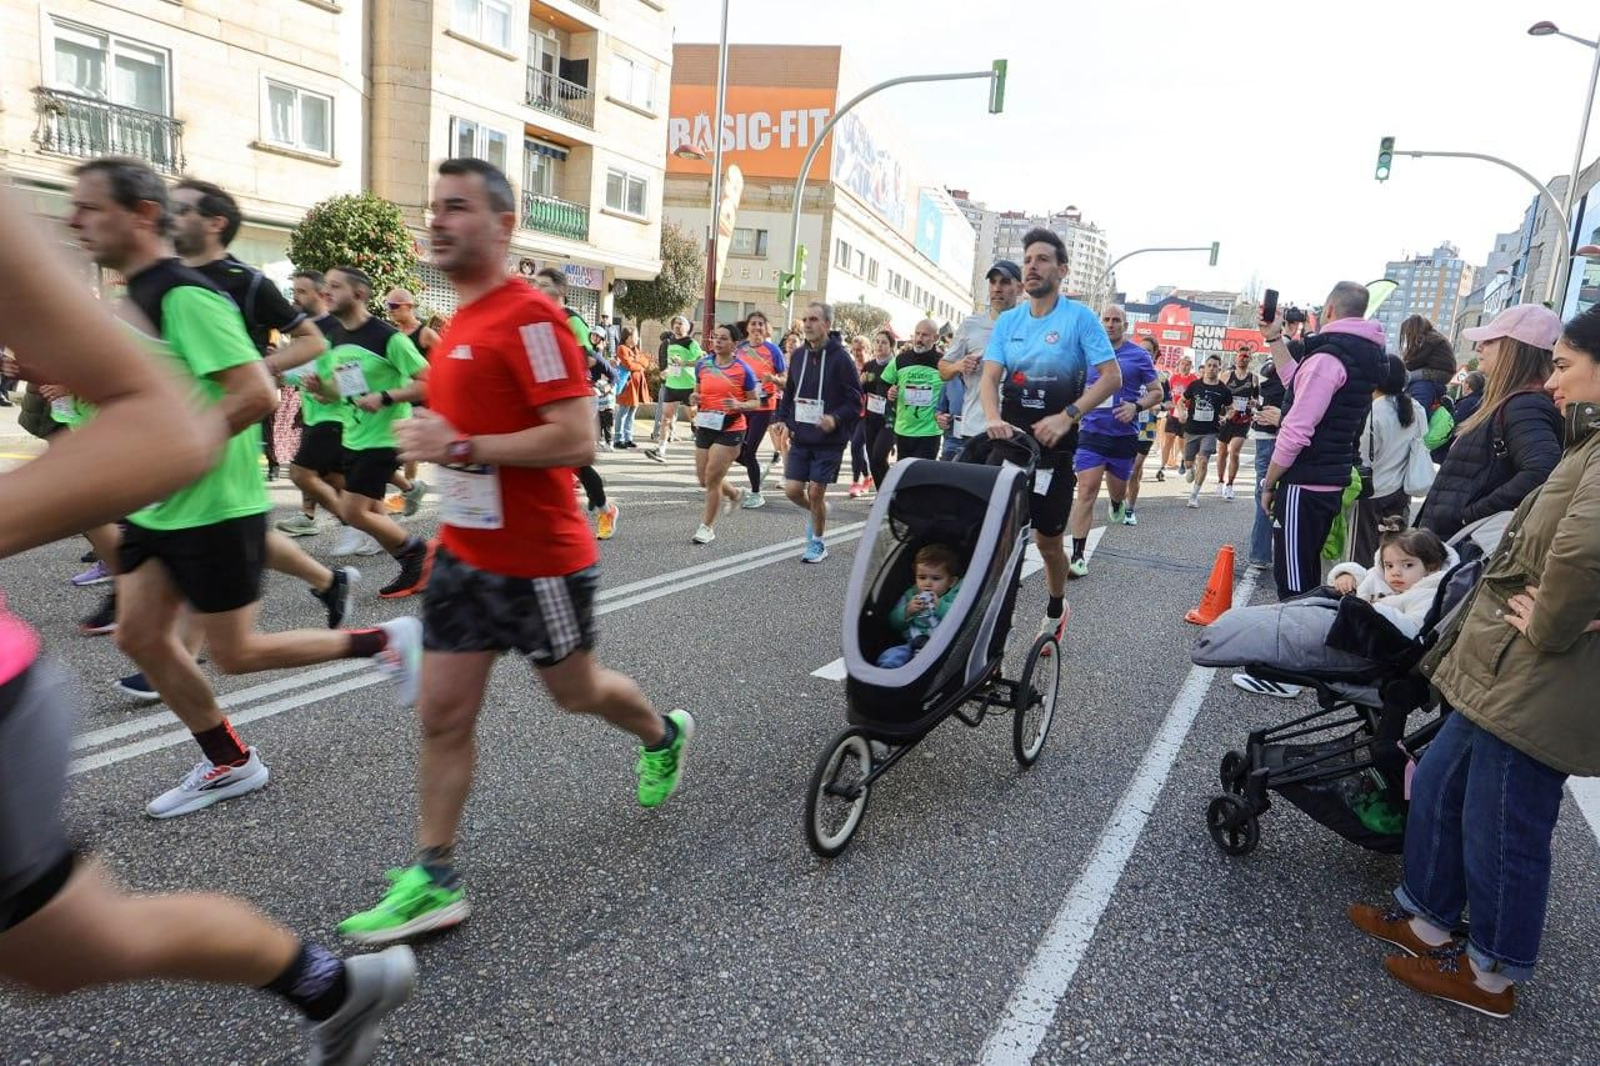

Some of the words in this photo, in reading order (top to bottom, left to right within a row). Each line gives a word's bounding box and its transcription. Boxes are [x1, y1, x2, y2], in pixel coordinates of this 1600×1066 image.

[669, 109, 830, 154] BASIC-FIT
[1194, 325, 1226, 339] RUN
[1192, 337, 1222, 351] RUN
